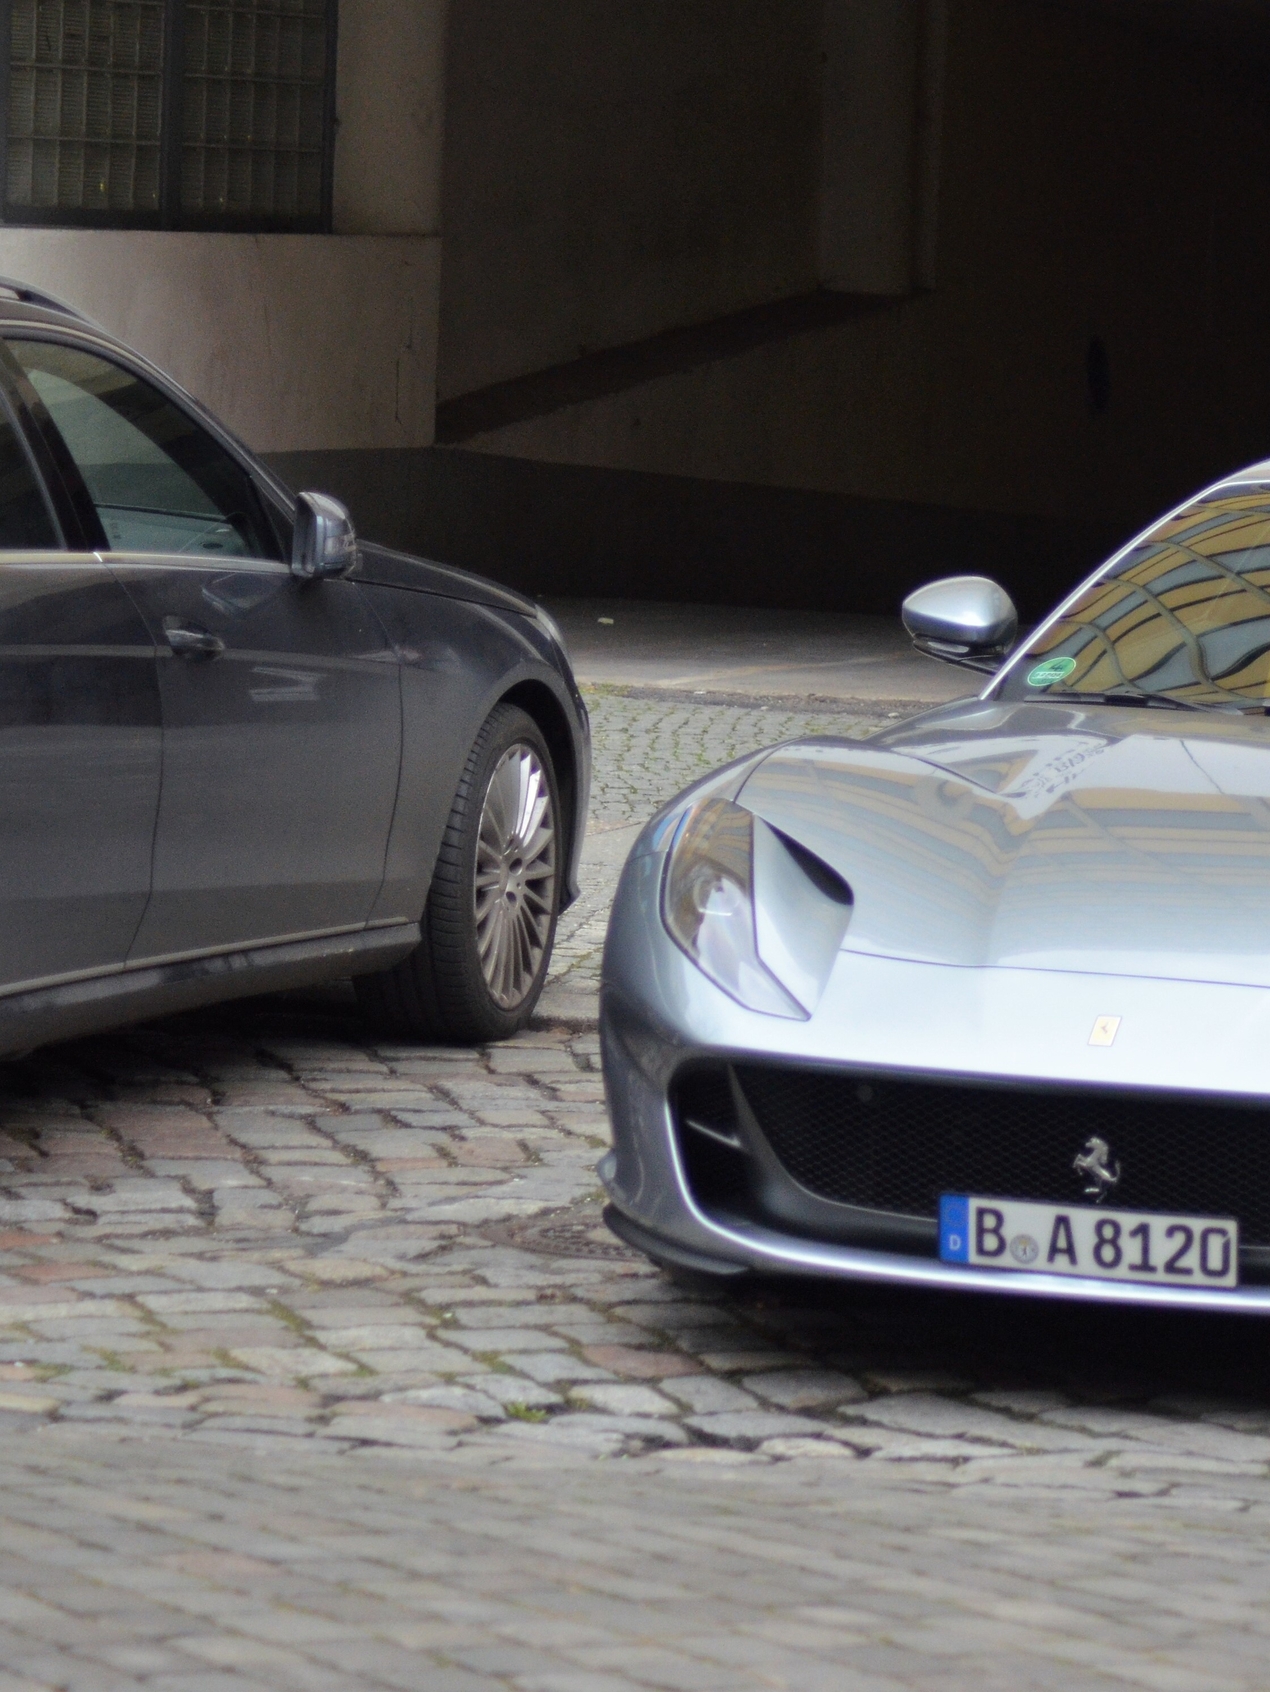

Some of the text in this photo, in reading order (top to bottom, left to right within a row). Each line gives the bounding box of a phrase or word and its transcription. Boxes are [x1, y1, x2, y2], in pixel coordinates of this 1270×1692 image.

[949, 1234, 961, 1251] D
[975, 1206, 1232, 1279] B A 8120
